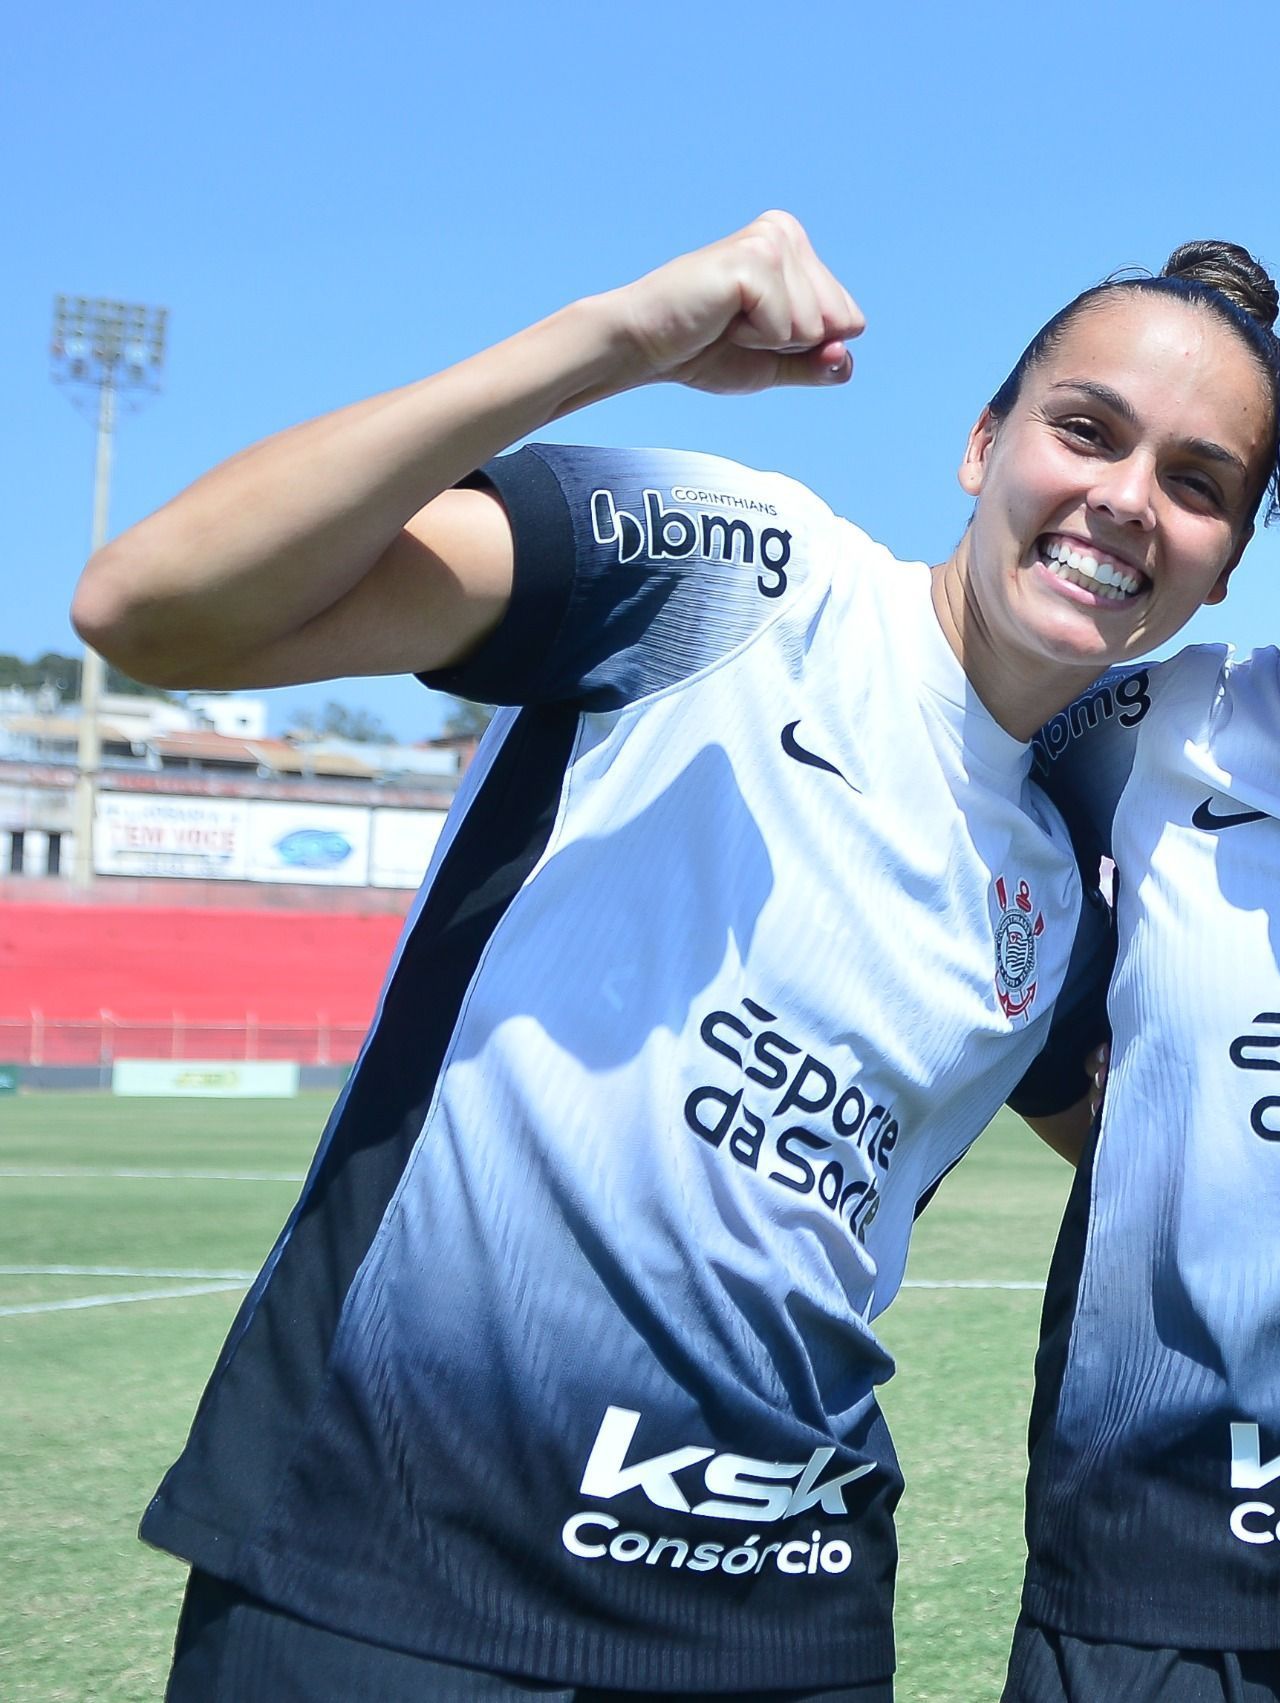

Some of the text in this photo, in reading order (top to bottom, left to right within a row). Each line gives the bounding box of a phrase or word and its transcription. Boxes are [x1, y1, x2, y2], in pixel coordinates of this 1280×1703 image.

[643, 489, 793, 598] bmg
[674, 489, 778, 516] CORINTHIANS
[1042, 668, 1152, 760] bmg
[700, 997, 899, 1171] Esporte
[684, 1086, 881, 1246] da Sorte
[561, 1511, 853, 1575] Consórcio
